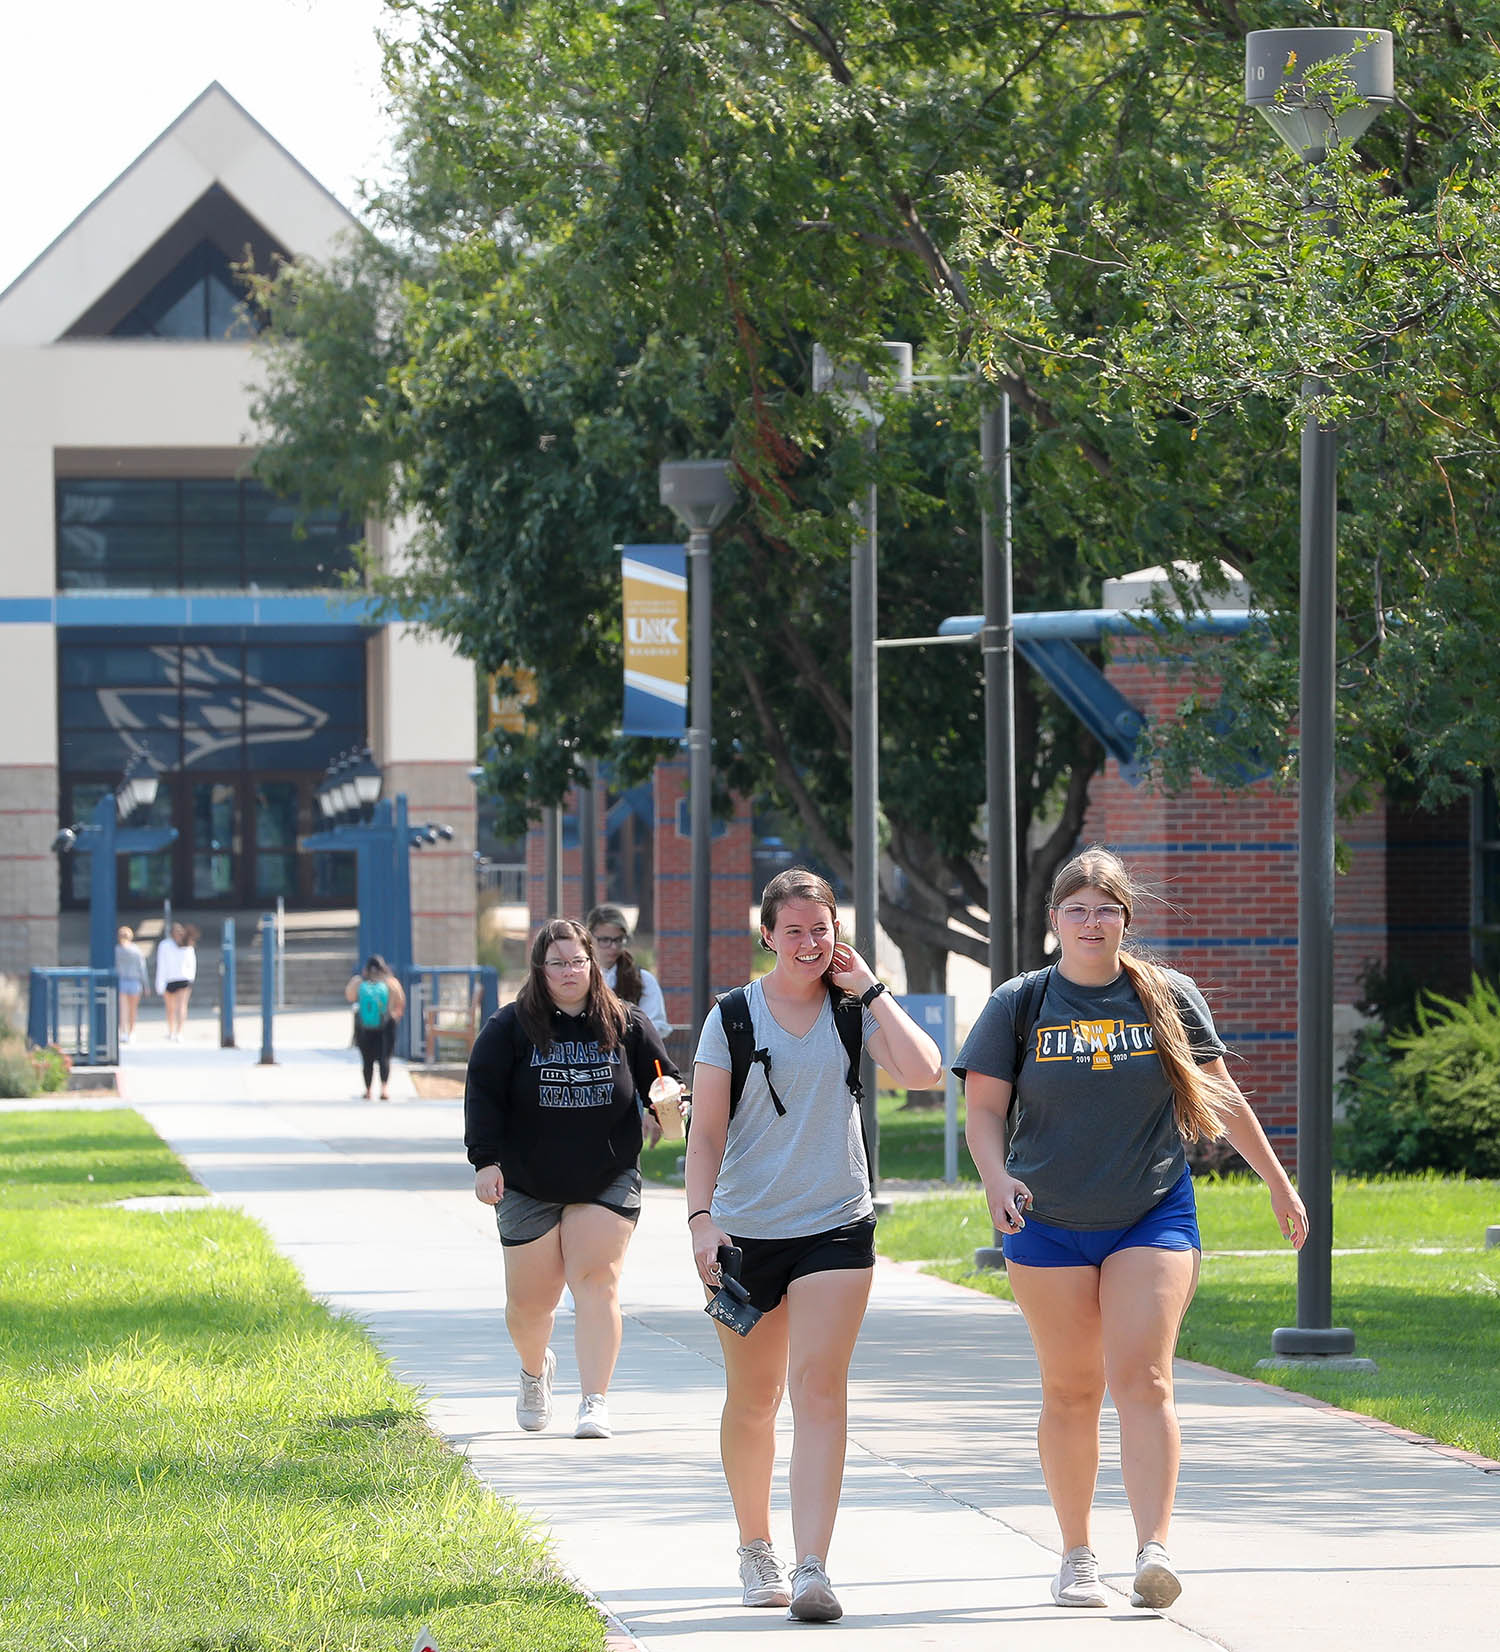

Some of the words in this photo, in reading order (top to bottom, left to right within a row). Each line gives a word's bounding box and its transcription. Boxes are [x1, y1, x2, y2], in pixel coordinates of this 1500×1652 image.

[626, 617, 682, 645] UNK
[1076, 1056, 1090, 1064] 2019
[1113, 1053, 1128, 1062] 2020
[538, 1083, 614, 1107] KEARNEY
